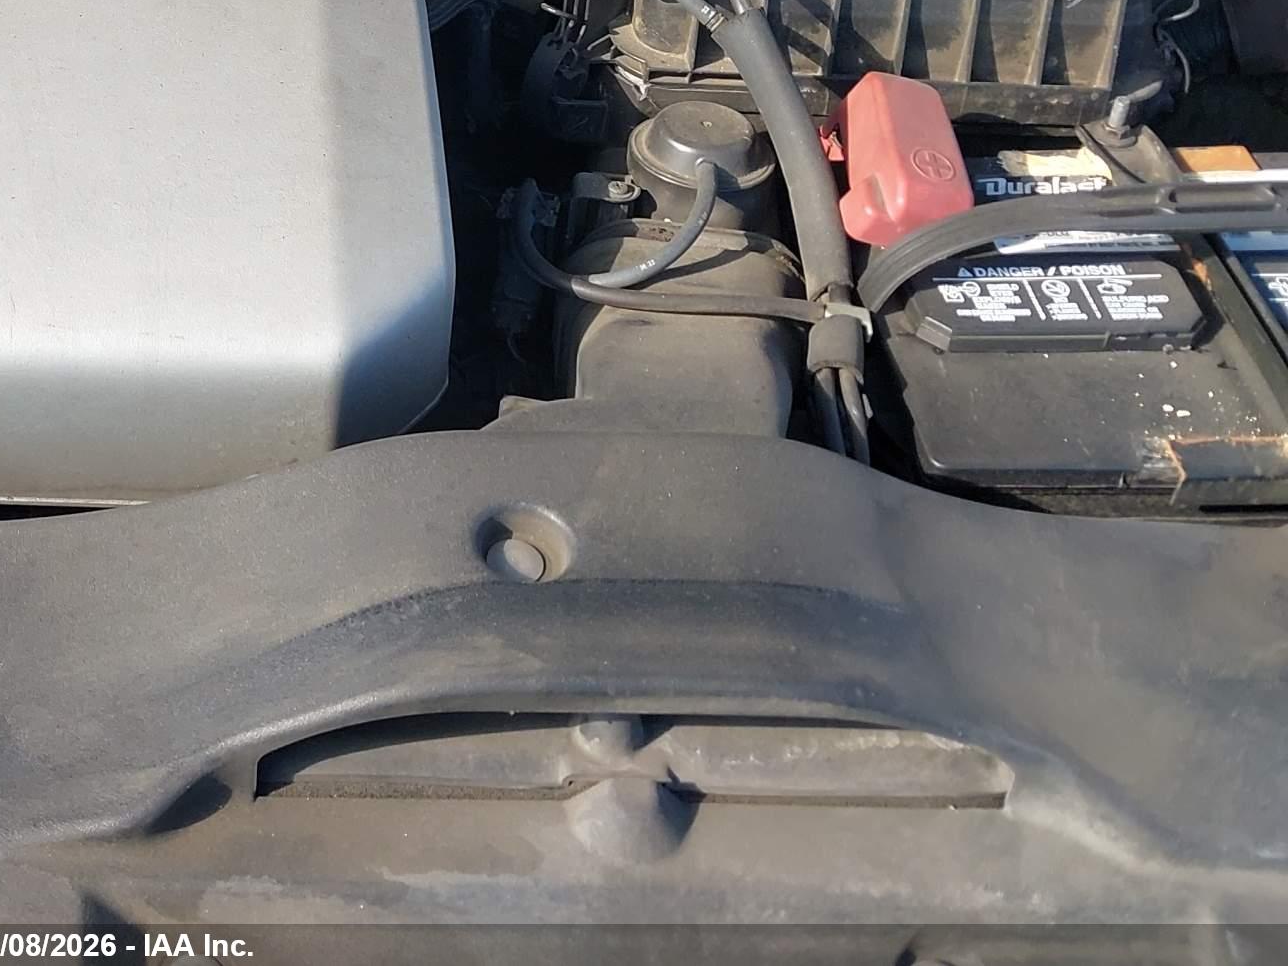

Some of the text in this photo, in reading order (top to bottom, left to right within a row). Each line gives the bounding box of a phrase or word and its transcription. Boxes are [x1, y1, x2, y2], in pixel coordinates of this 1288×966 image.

[976, 176, 1107, 196] Duralast
[972, 266, 1046, 278] DANGER
[1059, 264, 1126, 277] POISON
